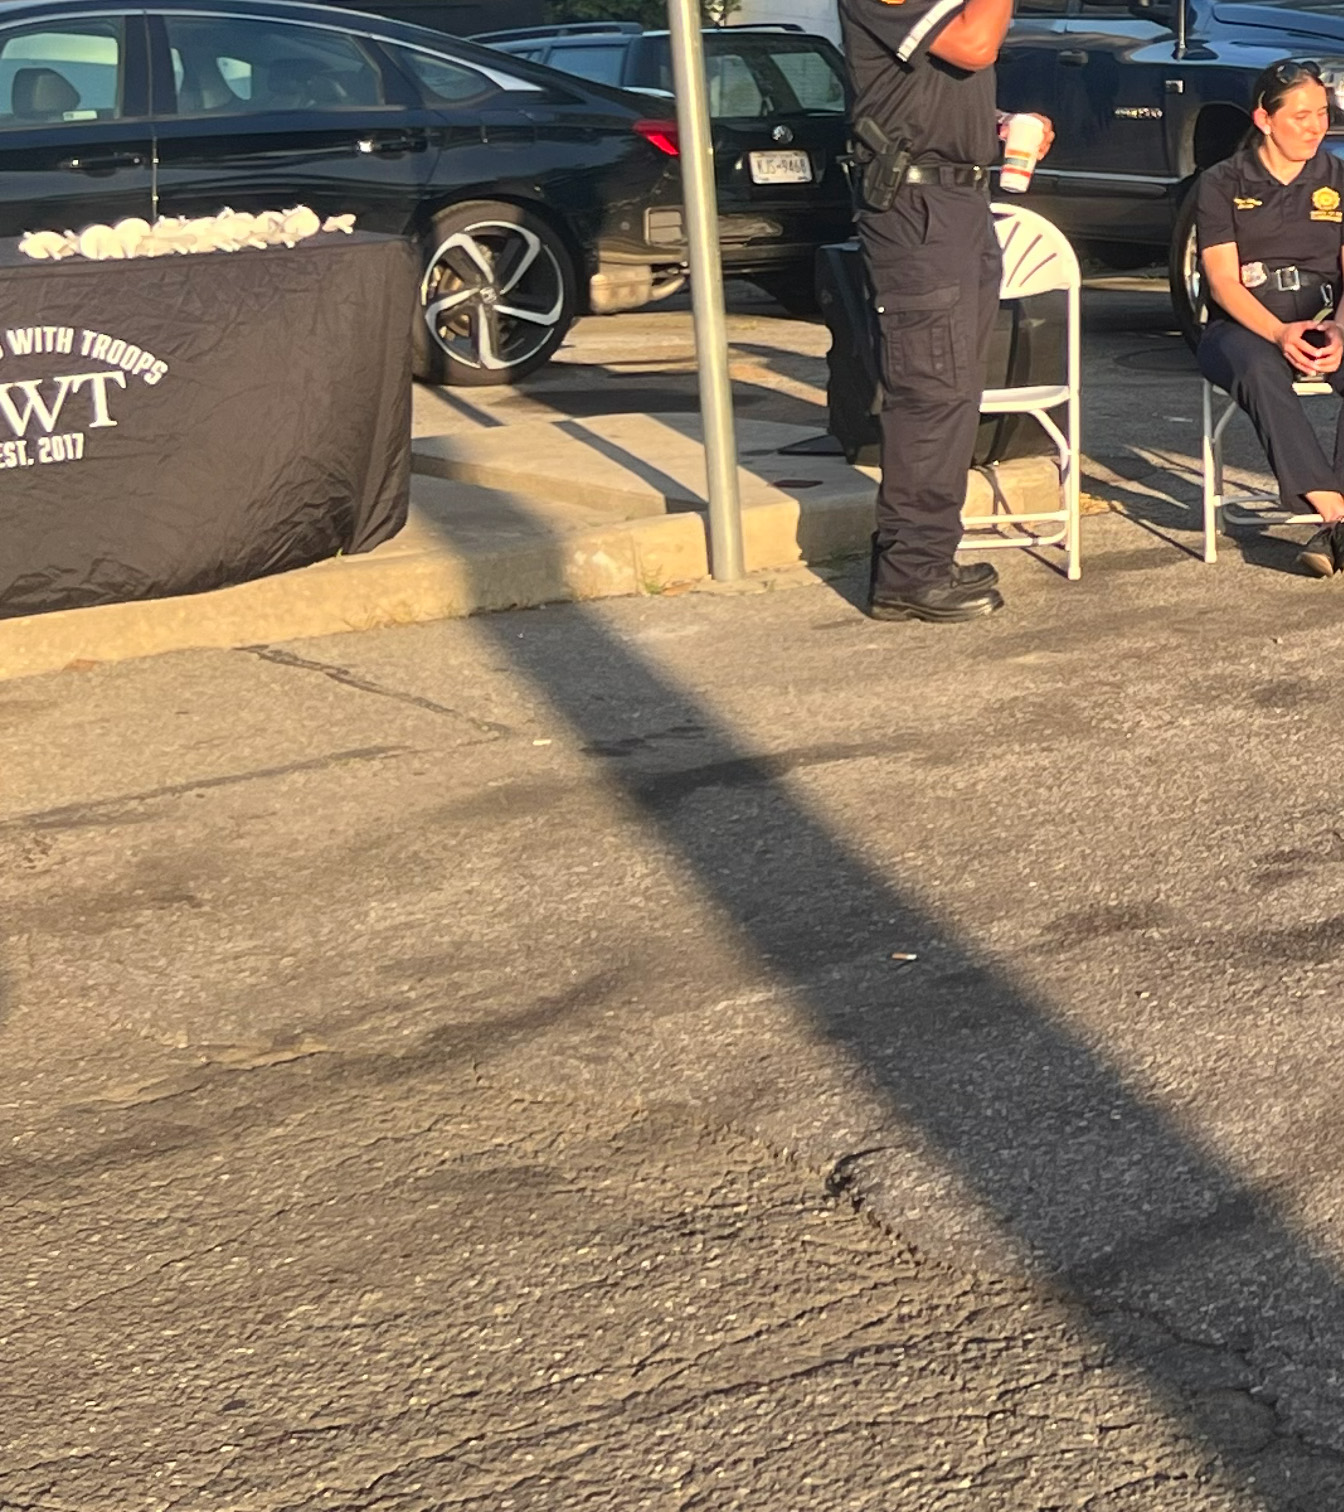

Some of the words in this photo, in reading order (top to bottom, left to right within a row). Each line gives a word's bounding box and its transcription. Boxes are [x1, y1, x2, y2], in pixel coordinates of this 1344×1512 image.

[6, 326, 75, 356] WITH
[81, 329, 169, 385] TROOPS
[38, 433, 84, 464] 2017
